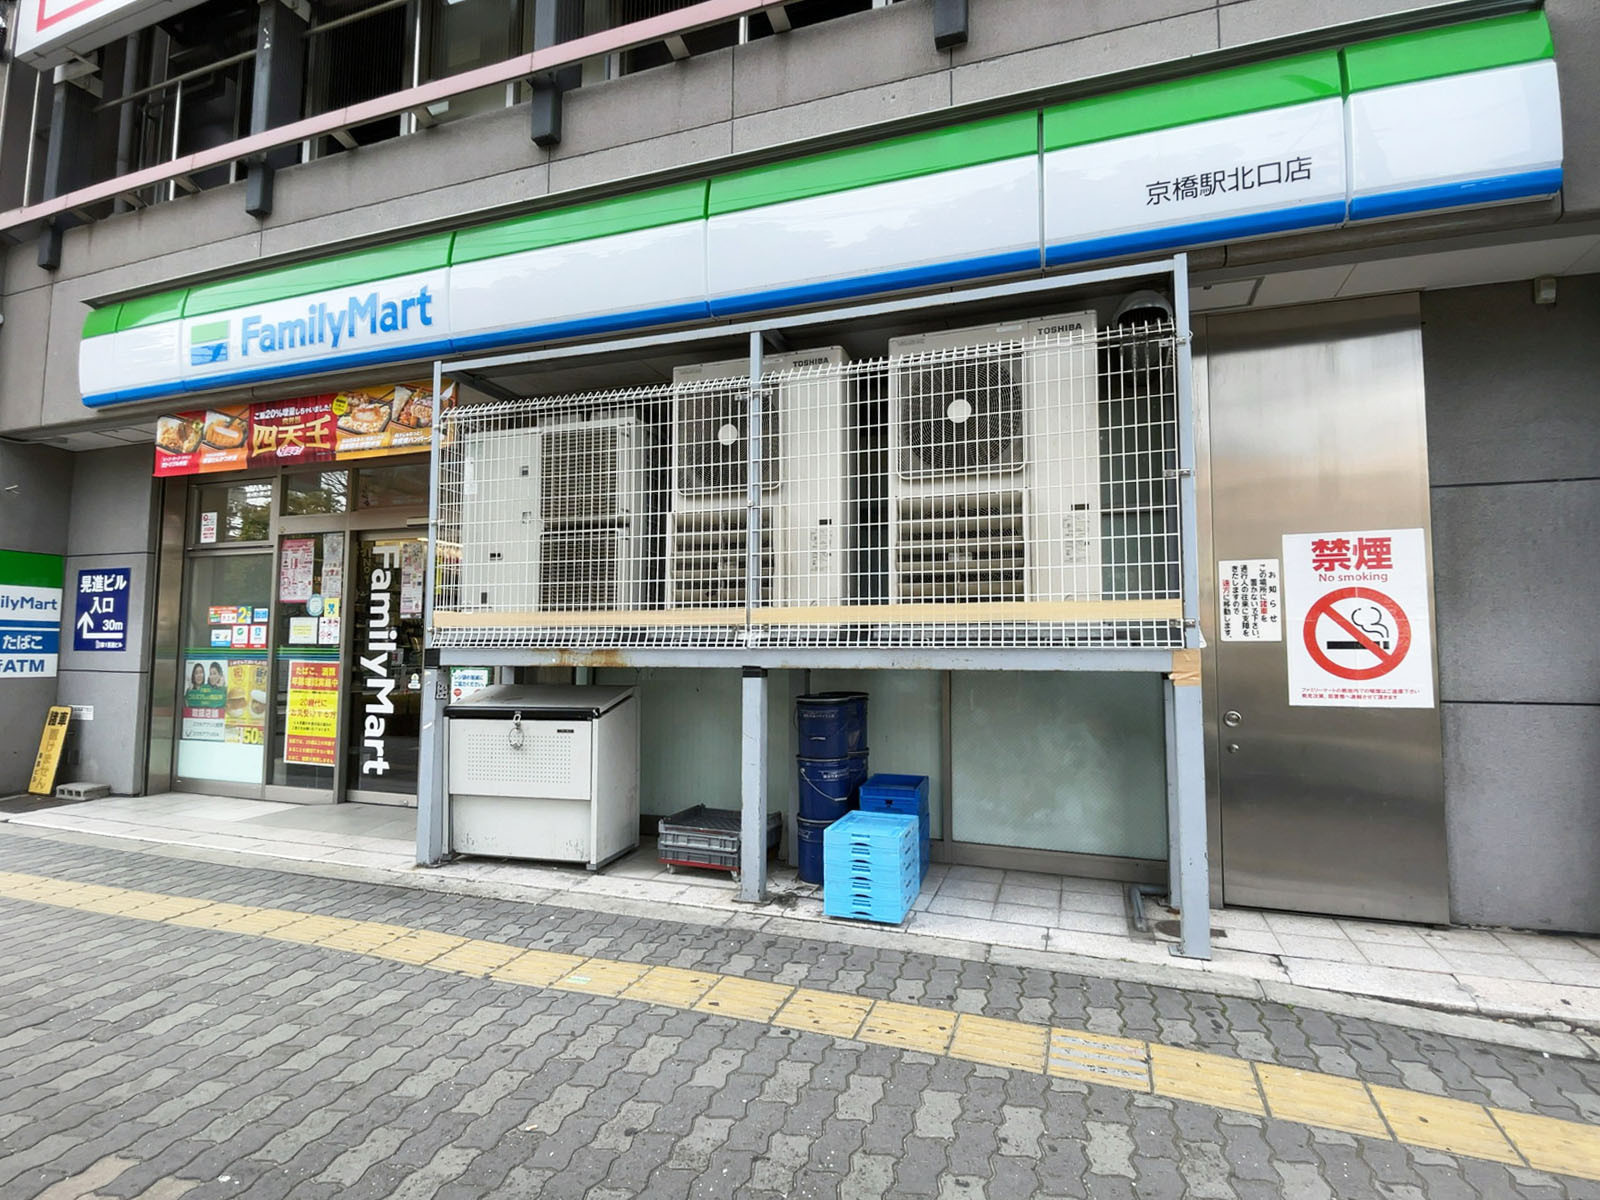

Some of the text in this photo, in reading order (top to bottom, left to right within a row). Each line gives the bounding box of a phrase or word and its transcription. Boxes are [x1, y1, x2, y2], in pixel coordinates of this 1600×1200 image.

[1146, 156, 1312, 206] 京橋駅北口店
[241, 286, 433, 357] FamilyMart
[1037, 323, 1083, 335] TOSHIBA
[793, 357, 829, 368] TOSHIBA
[251, 414, 332, 458] 四天王
[1311, 537, 1393, 572] 禁煙
[1318, 571, 1388, 583] No smoking
[90, 596, 114, 614] 入口
[1268, 571, 1278, 623] お知らせ
[102, 619, 123, 631] 30m
[2, 634, 43, 650] たばこ
[360, 545, 400, 775] FamilyMart
